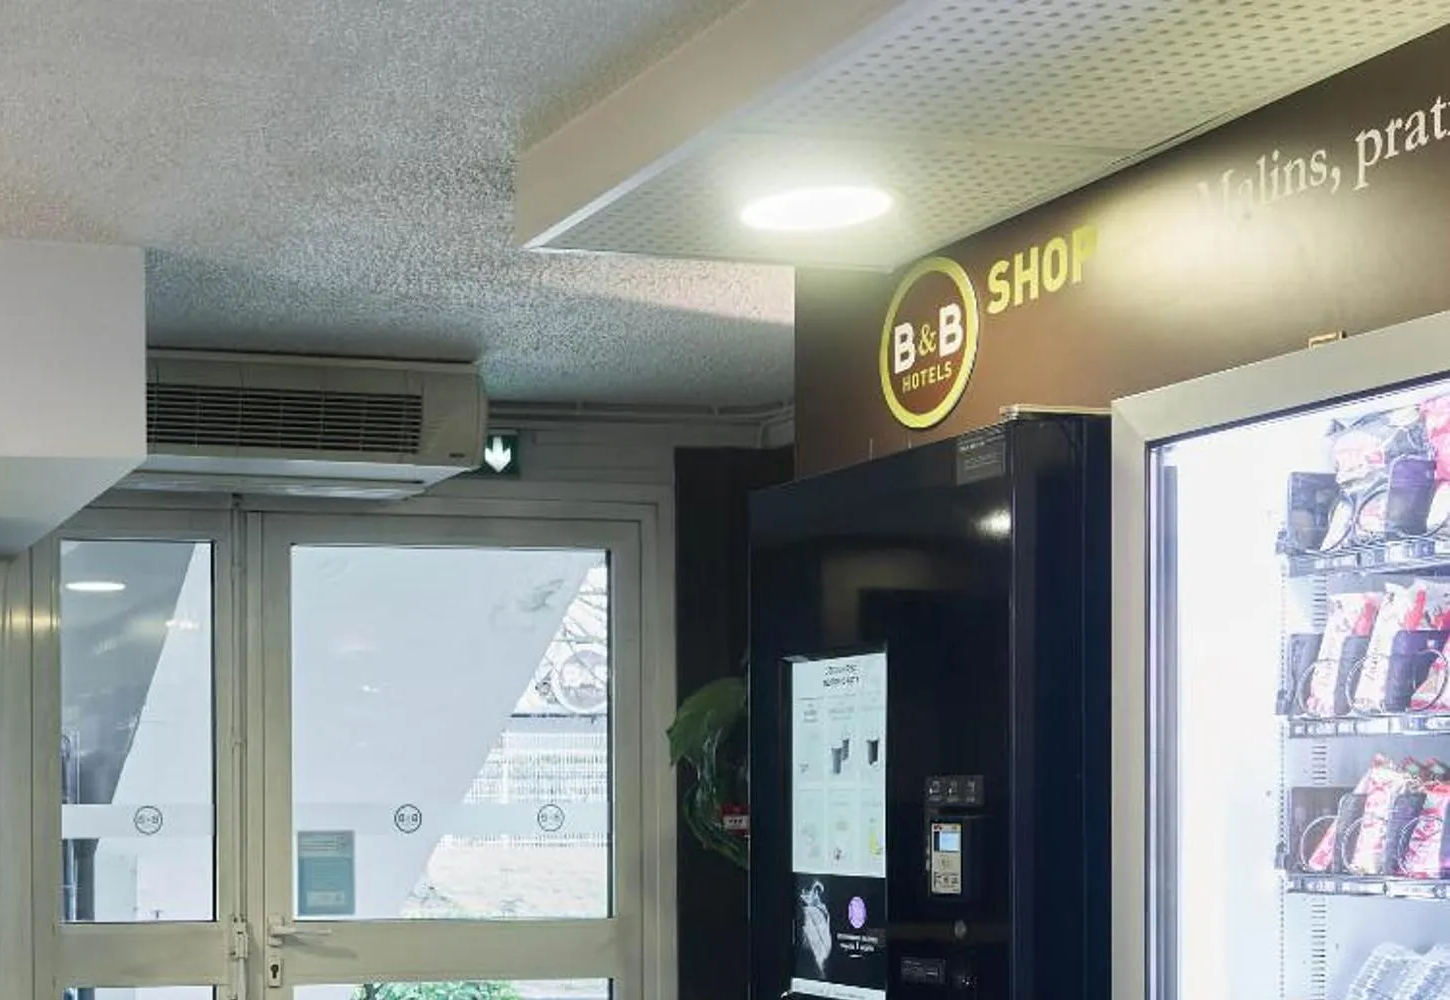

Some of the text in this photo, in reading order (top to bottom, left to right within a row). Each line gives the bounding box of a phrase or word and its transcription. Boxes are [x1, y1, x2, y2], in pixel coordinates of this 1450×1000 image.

[1353, 95, 1450, 191] prat
[986, 224, 1097, 314] SHOP
[894, 303, 963, 374] B&B
[902, 361, 952, 393] HOTELS
